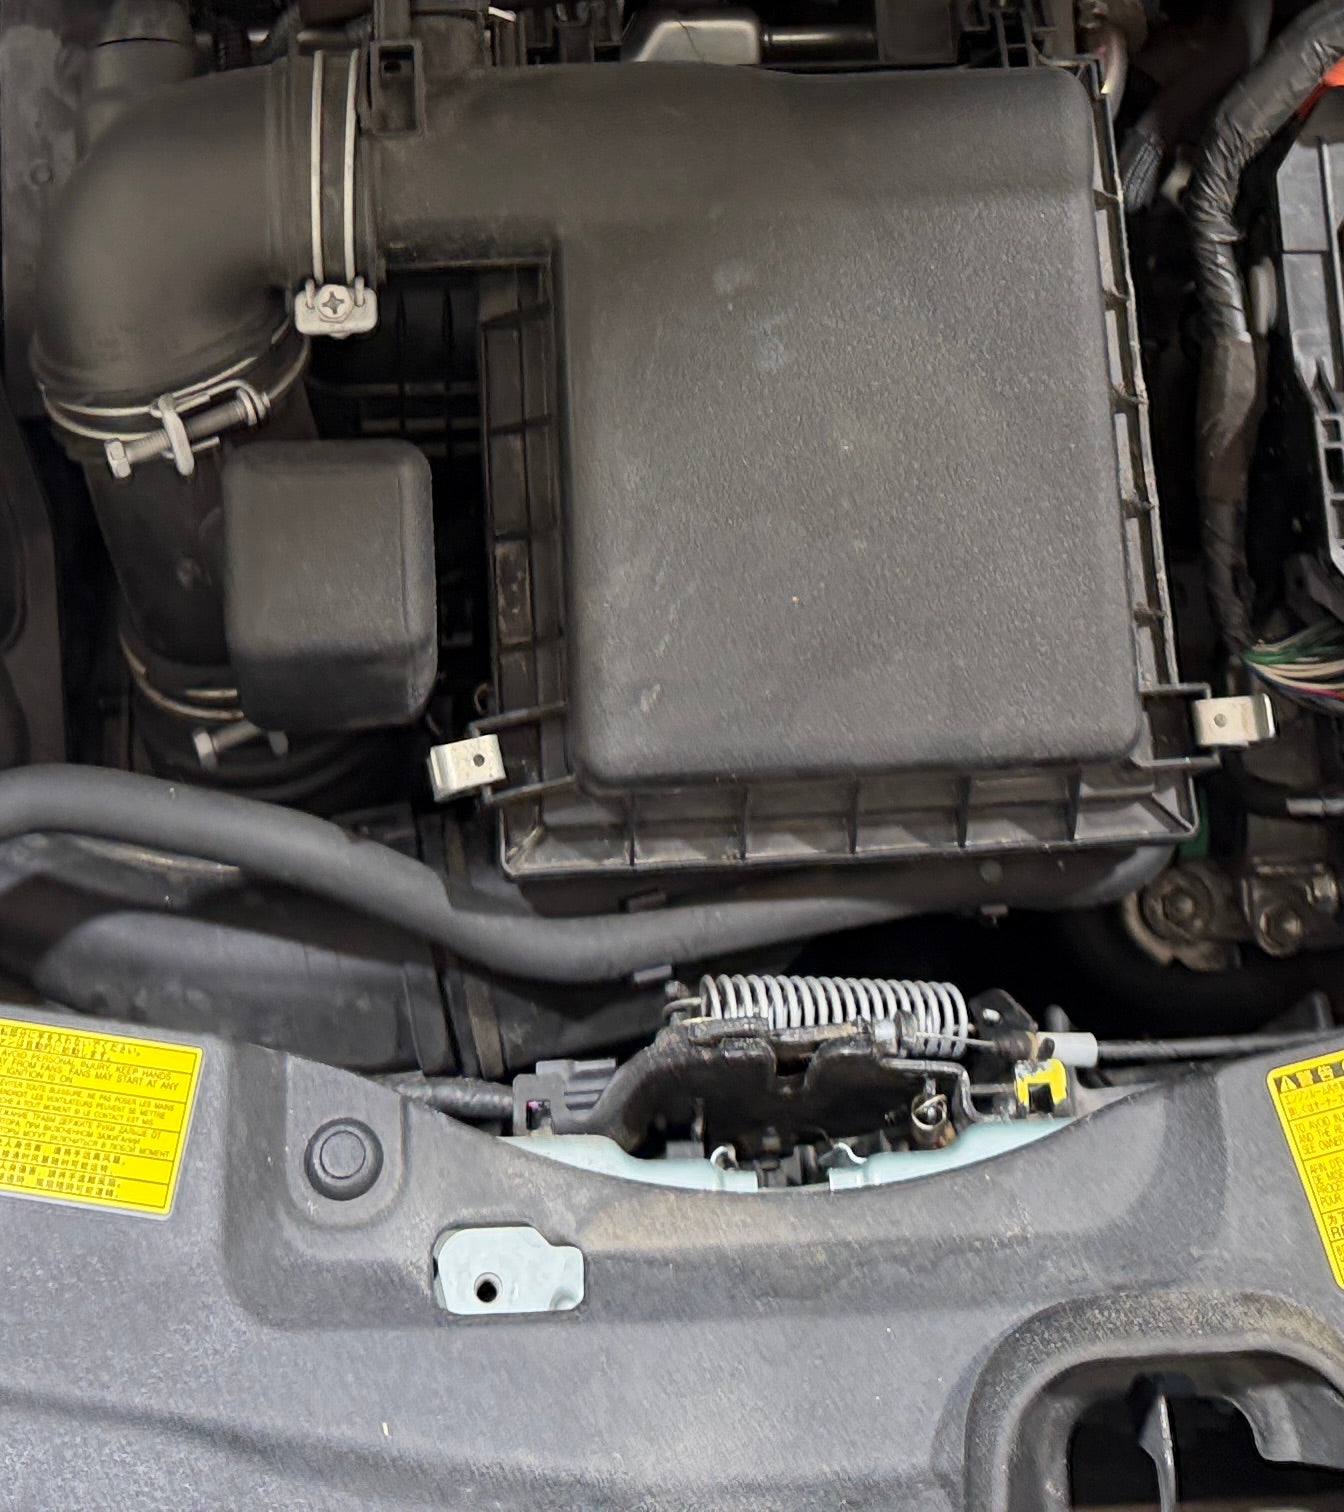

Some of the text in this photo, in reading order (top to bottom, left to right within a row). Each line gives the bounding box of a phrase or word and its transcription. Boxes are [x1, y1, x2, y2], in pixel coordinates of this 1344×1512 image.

[1, 1048, 27, 1059] AVOID
[30, 1052, 74, 1066] PERSONAL
[115, 1065, 138, 1076] KEEP
[141, 1068, 171, 1080] HANDS
[5, 1066, 44, 1079] IGNITION
[47, 1072, 56, 1081] IS
[11, 1058, 36, 1070] FROM
[68, 1066, 91, 1078] FANS
[94, 1070, 112, 1081] MAY
[116, 1074, 143, 1085] START
[146, 1078, 157, 1087] AT
[160, 1080, 179, 1091] ANY
[1294, 1122, 1305, 1133] TO
[1307, 1115, 1331, 1129] AVOID
[1297, 1131, 1313, 1144] AND
[1316, 1127, 1330, 1139] THE
[1301, 1142, 1316, 1155] SEE
[1311, 1173, 1323, 1185] DE
[1319, 1192, 1342, 1207] POUR
